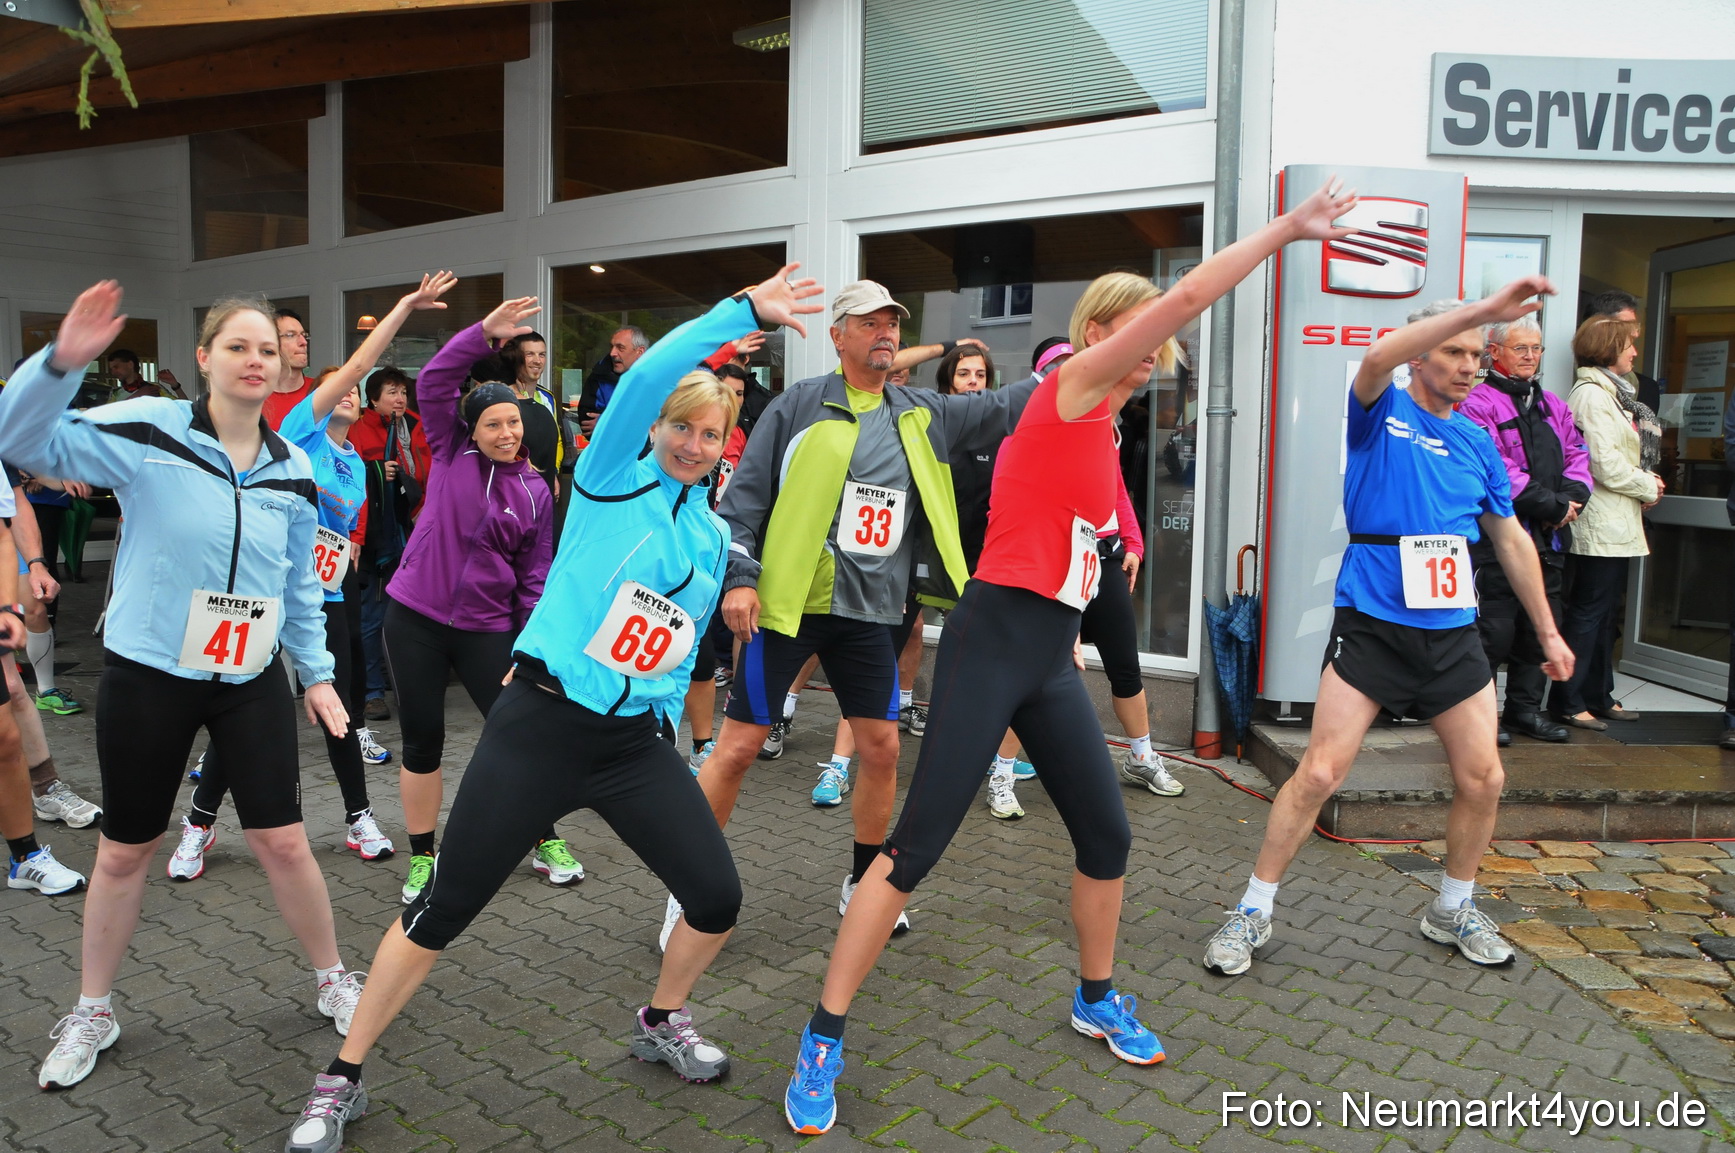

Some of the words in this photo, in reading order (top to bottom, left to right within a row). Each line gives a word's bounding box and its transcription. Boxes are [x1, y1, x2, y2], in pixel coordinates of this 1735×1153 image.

[855, 495, 885, 505] WERBUNG
[856, 487, 886, 499] MEYER
[317, 528, 339, 543] MEYER
[855, 505, 892, 548] 33
[1414, 540, 1448, 548] MEYER
[314, 544, 340, 582] 35
[1081, 550, 1097, 602] 12
[1425, 557, 1457, 598] 13
[206, 605, 249, 617] WERBUNG
[207, 595, 249, 609] MEYER
[631, 598, 668, 622] WERBUNG
[633, 588, 671, 615] MEYER
[203, 620, 250, 666] 41
[611, 615, 672, 672] 69
